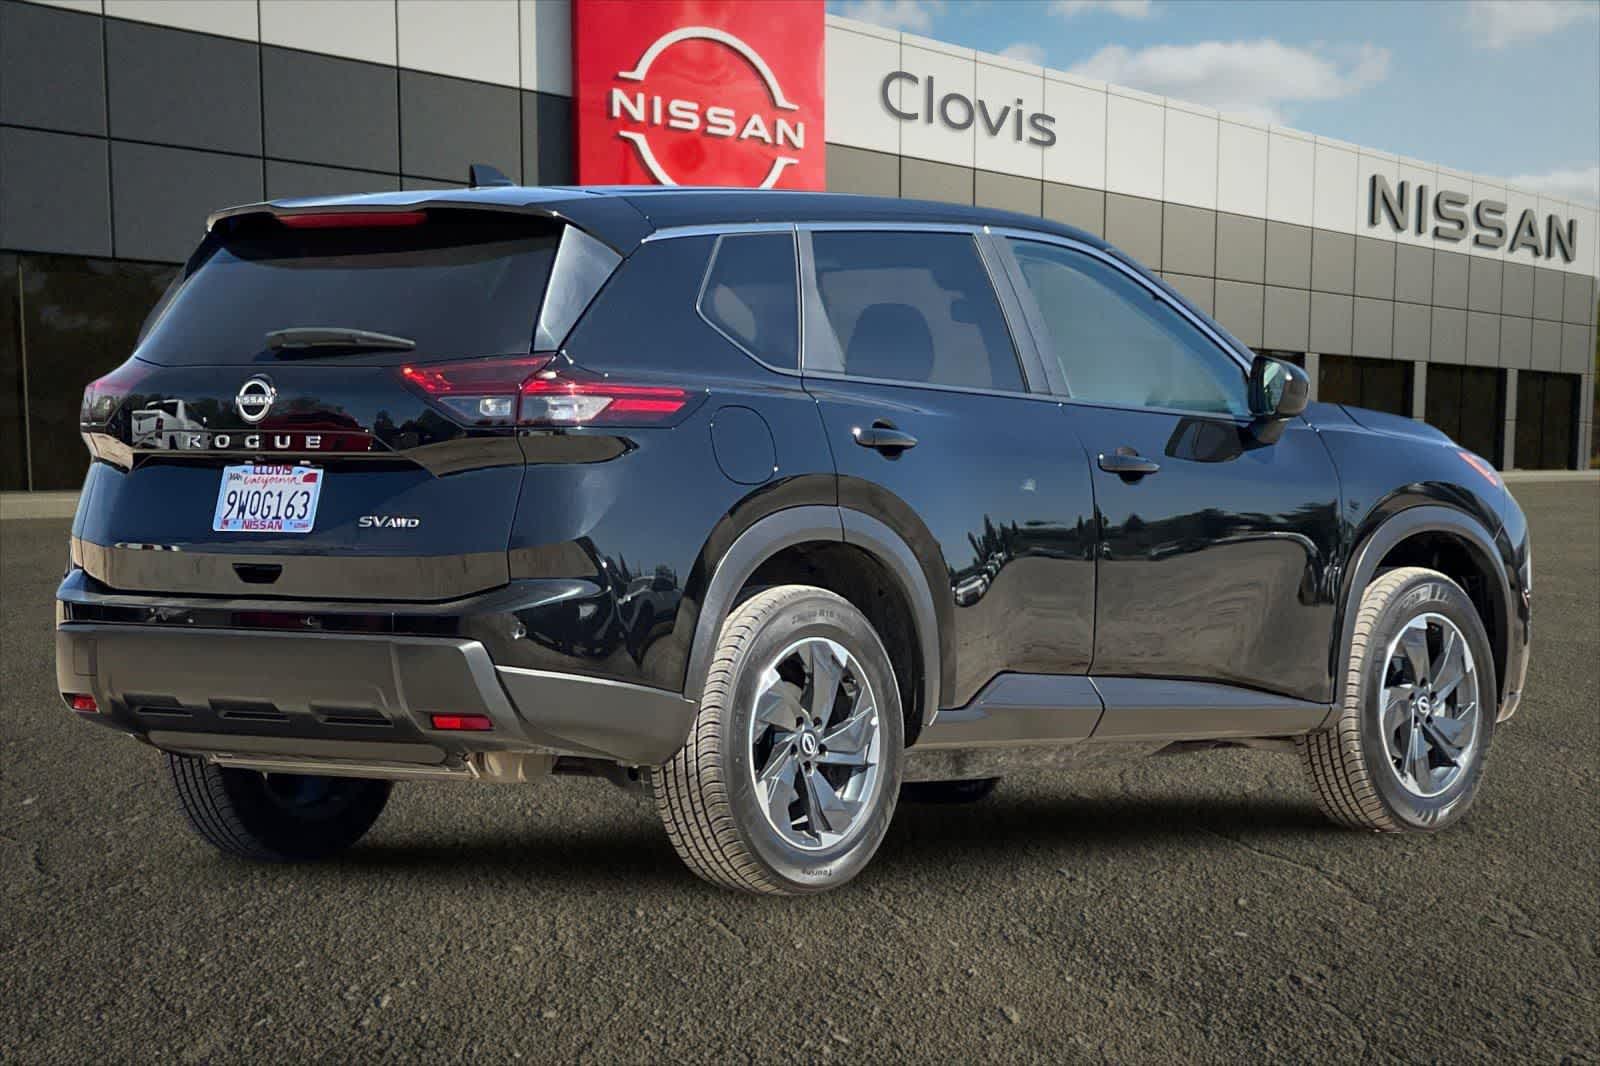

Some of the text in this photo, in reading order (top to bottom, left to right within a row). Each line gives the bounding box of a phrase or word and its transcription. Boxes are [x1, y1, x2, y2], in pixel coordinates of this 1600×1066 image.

[610, 87, 806, 148] NISSAN
[881, 70, 1057, 147] Clovis
[1369, 173, 1577, 263] NISSAN
[188, 434, 322, 448] ROGUE
[224, 490, 311, 520] 9WQG163
[242, 519, 283, 530] NISSAN
